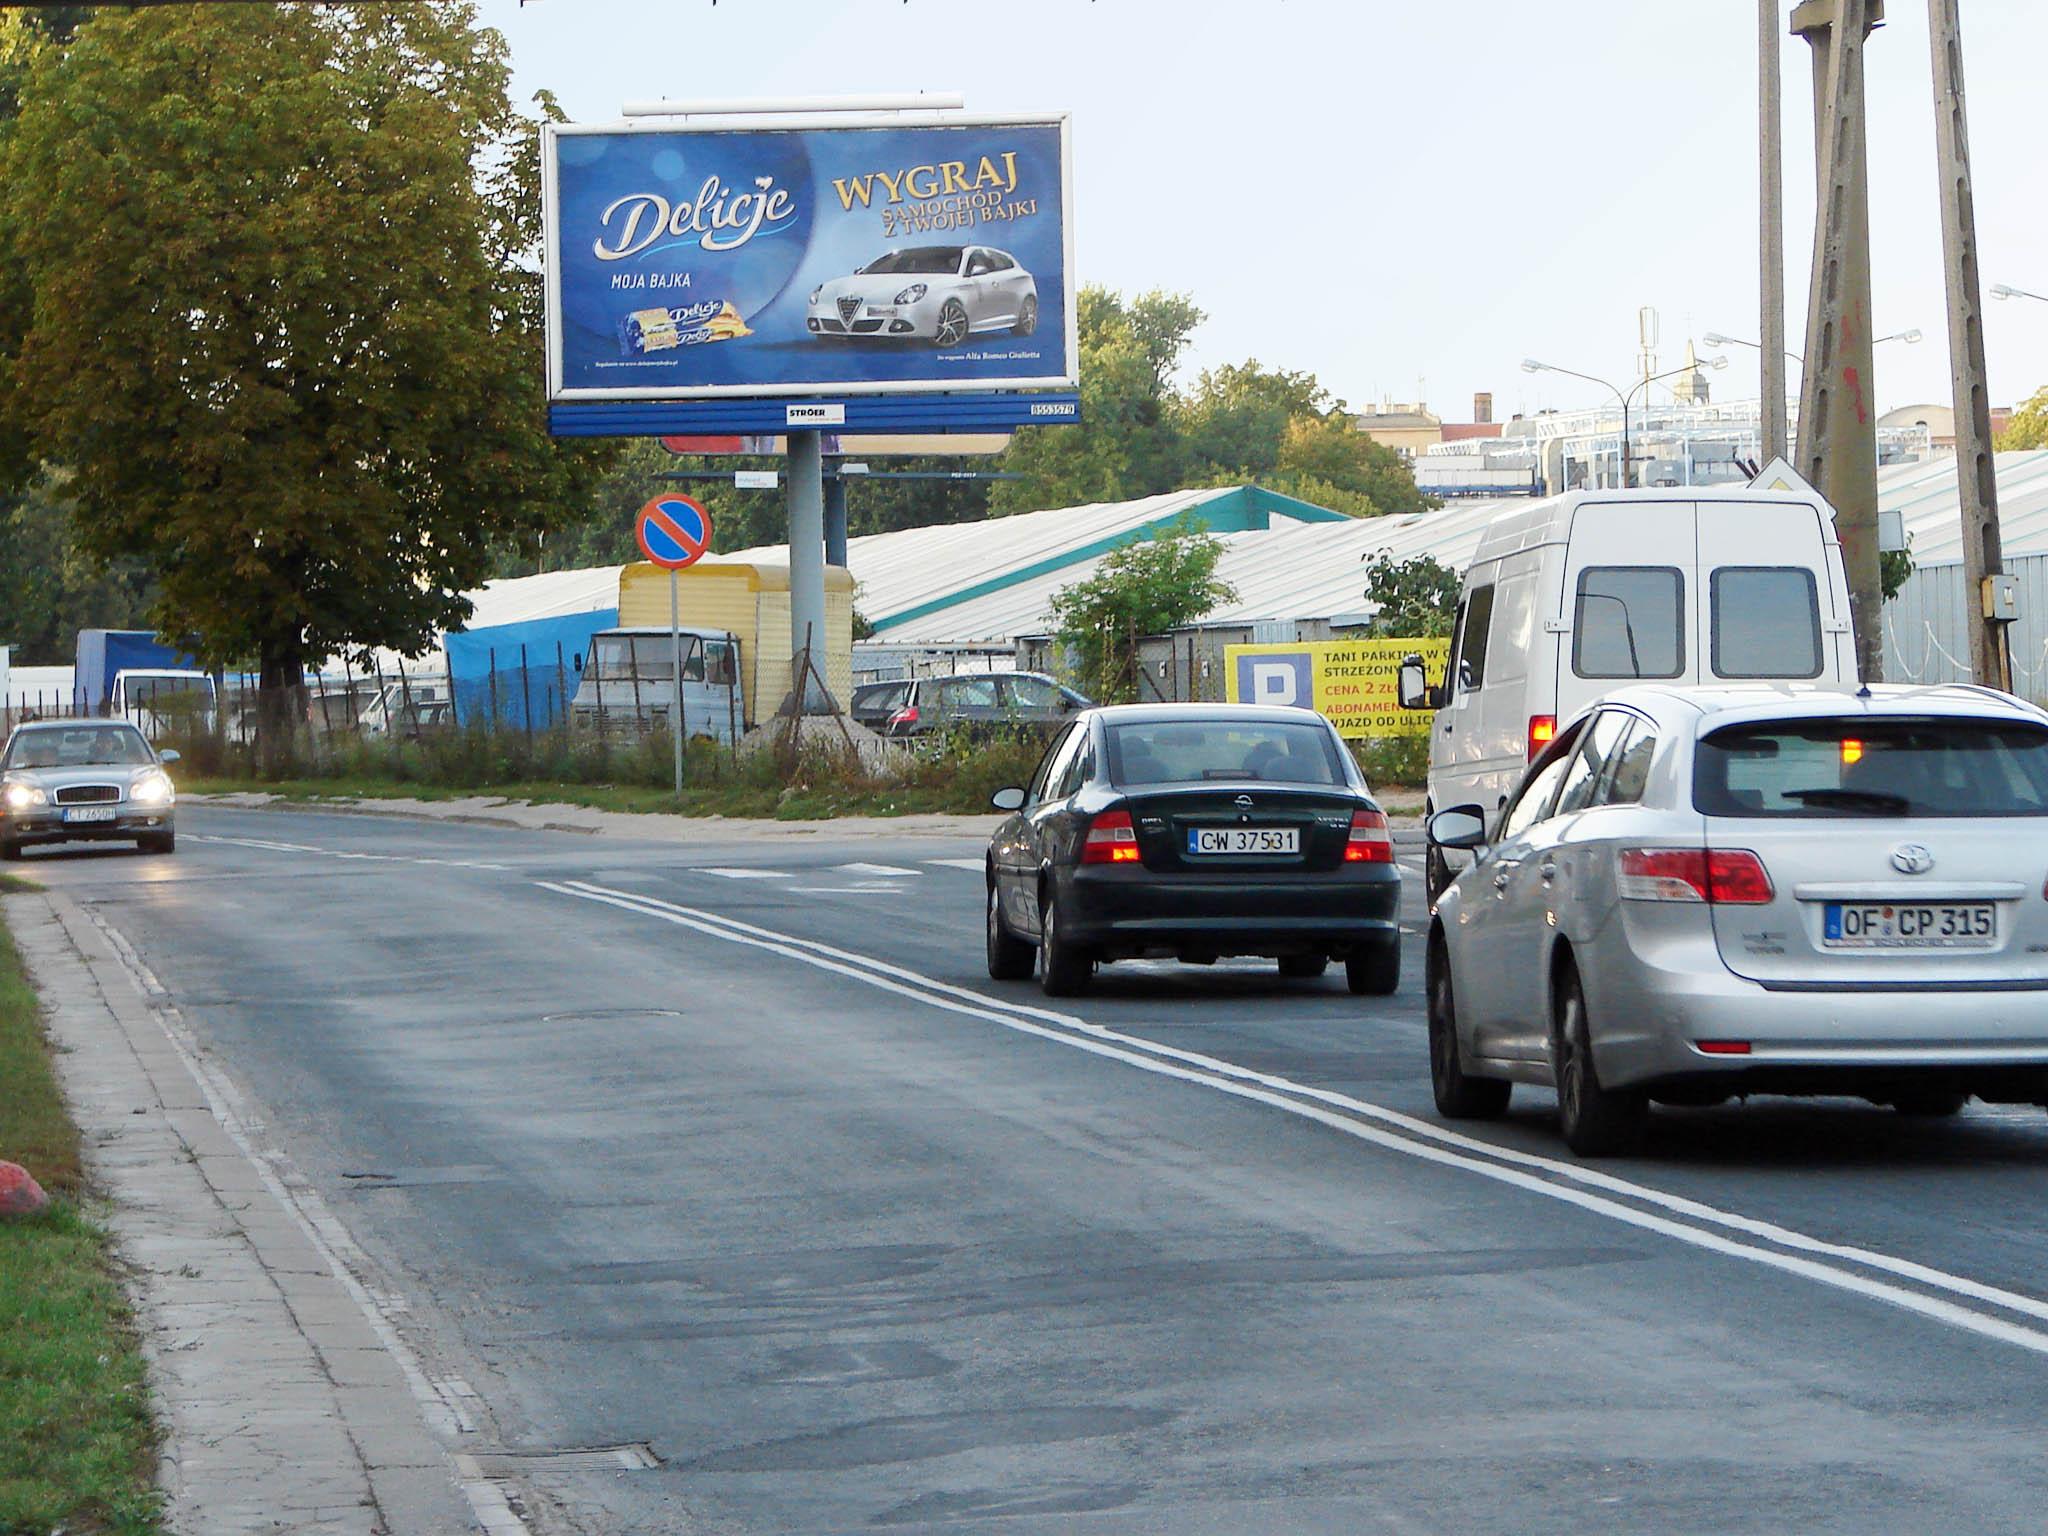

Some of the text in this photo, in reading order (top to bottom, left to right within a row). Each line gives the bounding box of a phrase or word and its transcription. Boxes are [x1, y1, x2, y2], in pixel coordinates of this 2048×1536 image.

[832, 152, 1017, 210] WYGRAJ
[881, 190, 1002, 224] SAMOCHÓD
[594, 175, 795, 260] Delicje
[884, 199, 1039, 238] Z TWOJEJ BAJKI
[611, 273, 691, 289] MOJA BAJKA
[965, 352, 981, 360] Alfa
[1324, 652, 1356, 663] TANI
[1426, 650, 1438, 659] W
[1325, 685, 1360, 696] CENA
[1365, 682, 1375, 694] 2
[1376, 716, 1396, 727] OD
[1201, 832, 1229, 850] CW
[1236, 832, 1293, 850] 37531
[1844, 908, 1991, 936] OF CP 315
